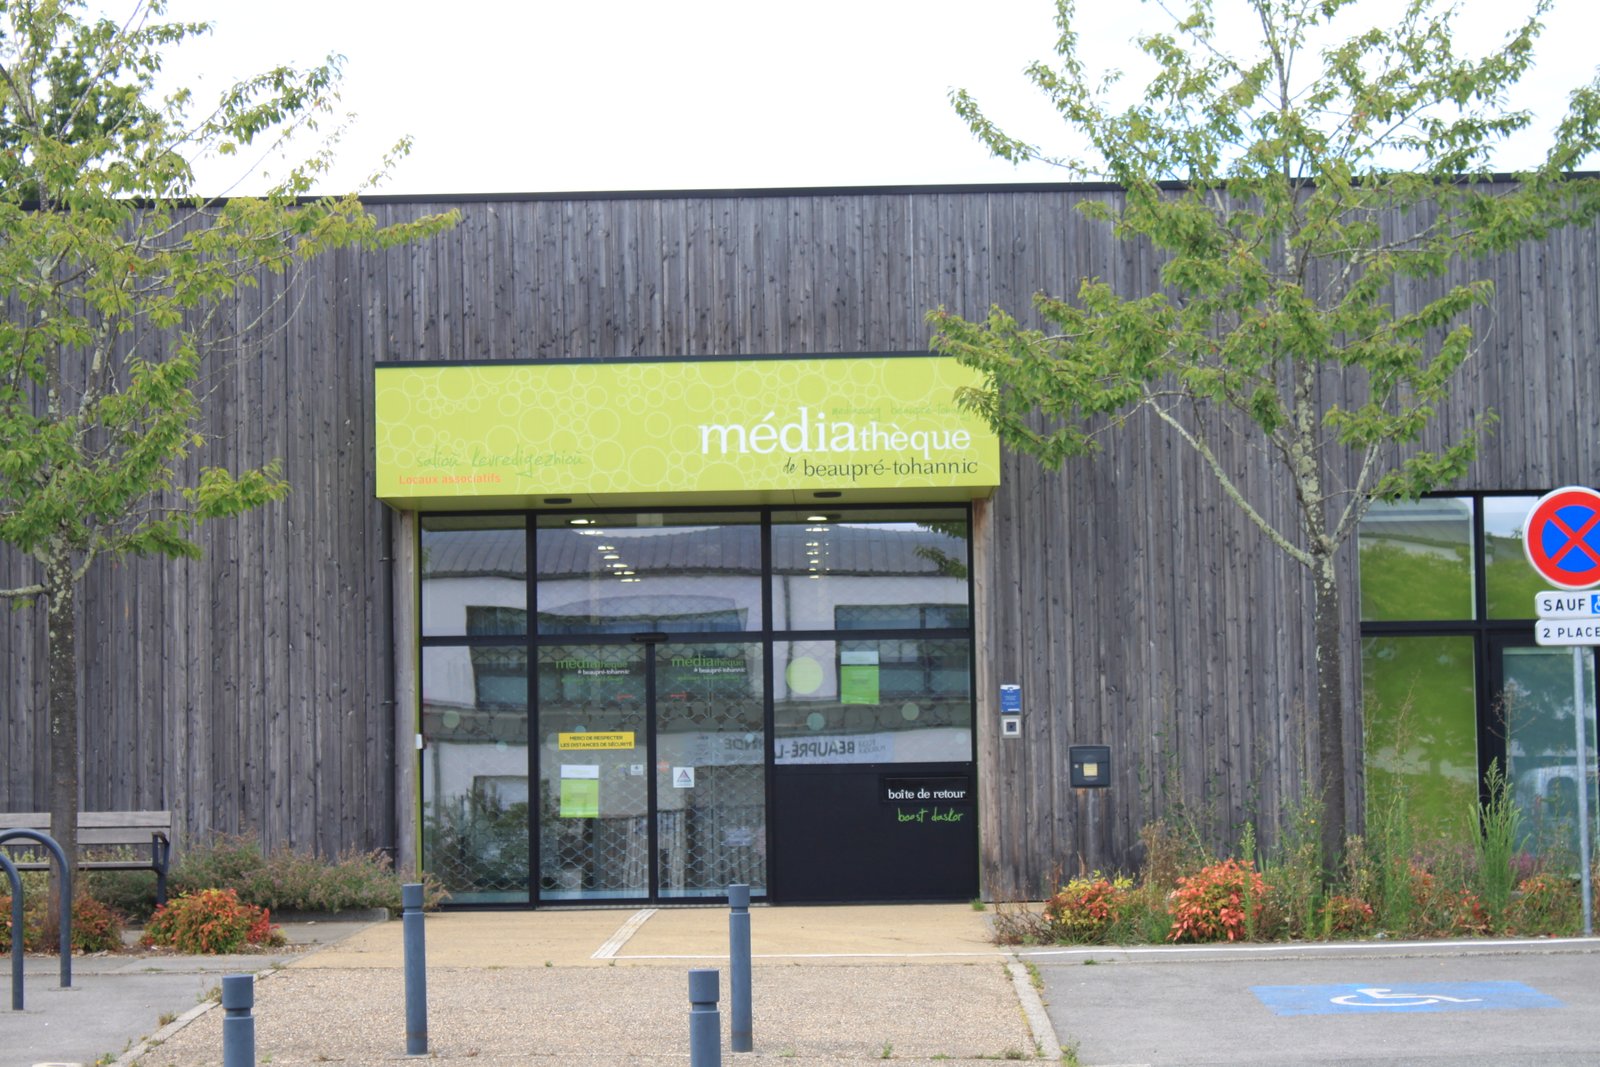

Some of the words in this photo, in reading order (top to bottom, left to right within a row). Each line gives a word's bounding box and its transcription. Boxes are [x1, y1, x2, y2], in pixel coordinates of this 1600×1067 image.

[699, 407, 970, 460] médiathèque
[783, 457, 797, 475] de
[804, 457, 978, 482] beaupré-tohannic
[400, 475, 438, 485] Locaux
[442, 473, 502, 484] associatifs
[1543, 598, 1586, 612] SAUF
[1543, 627, 1551, 639] 2
[888, 788, 915, 799] boîte
[917, 787, 931, 799] de
[933, 789, 966, 799] retour
